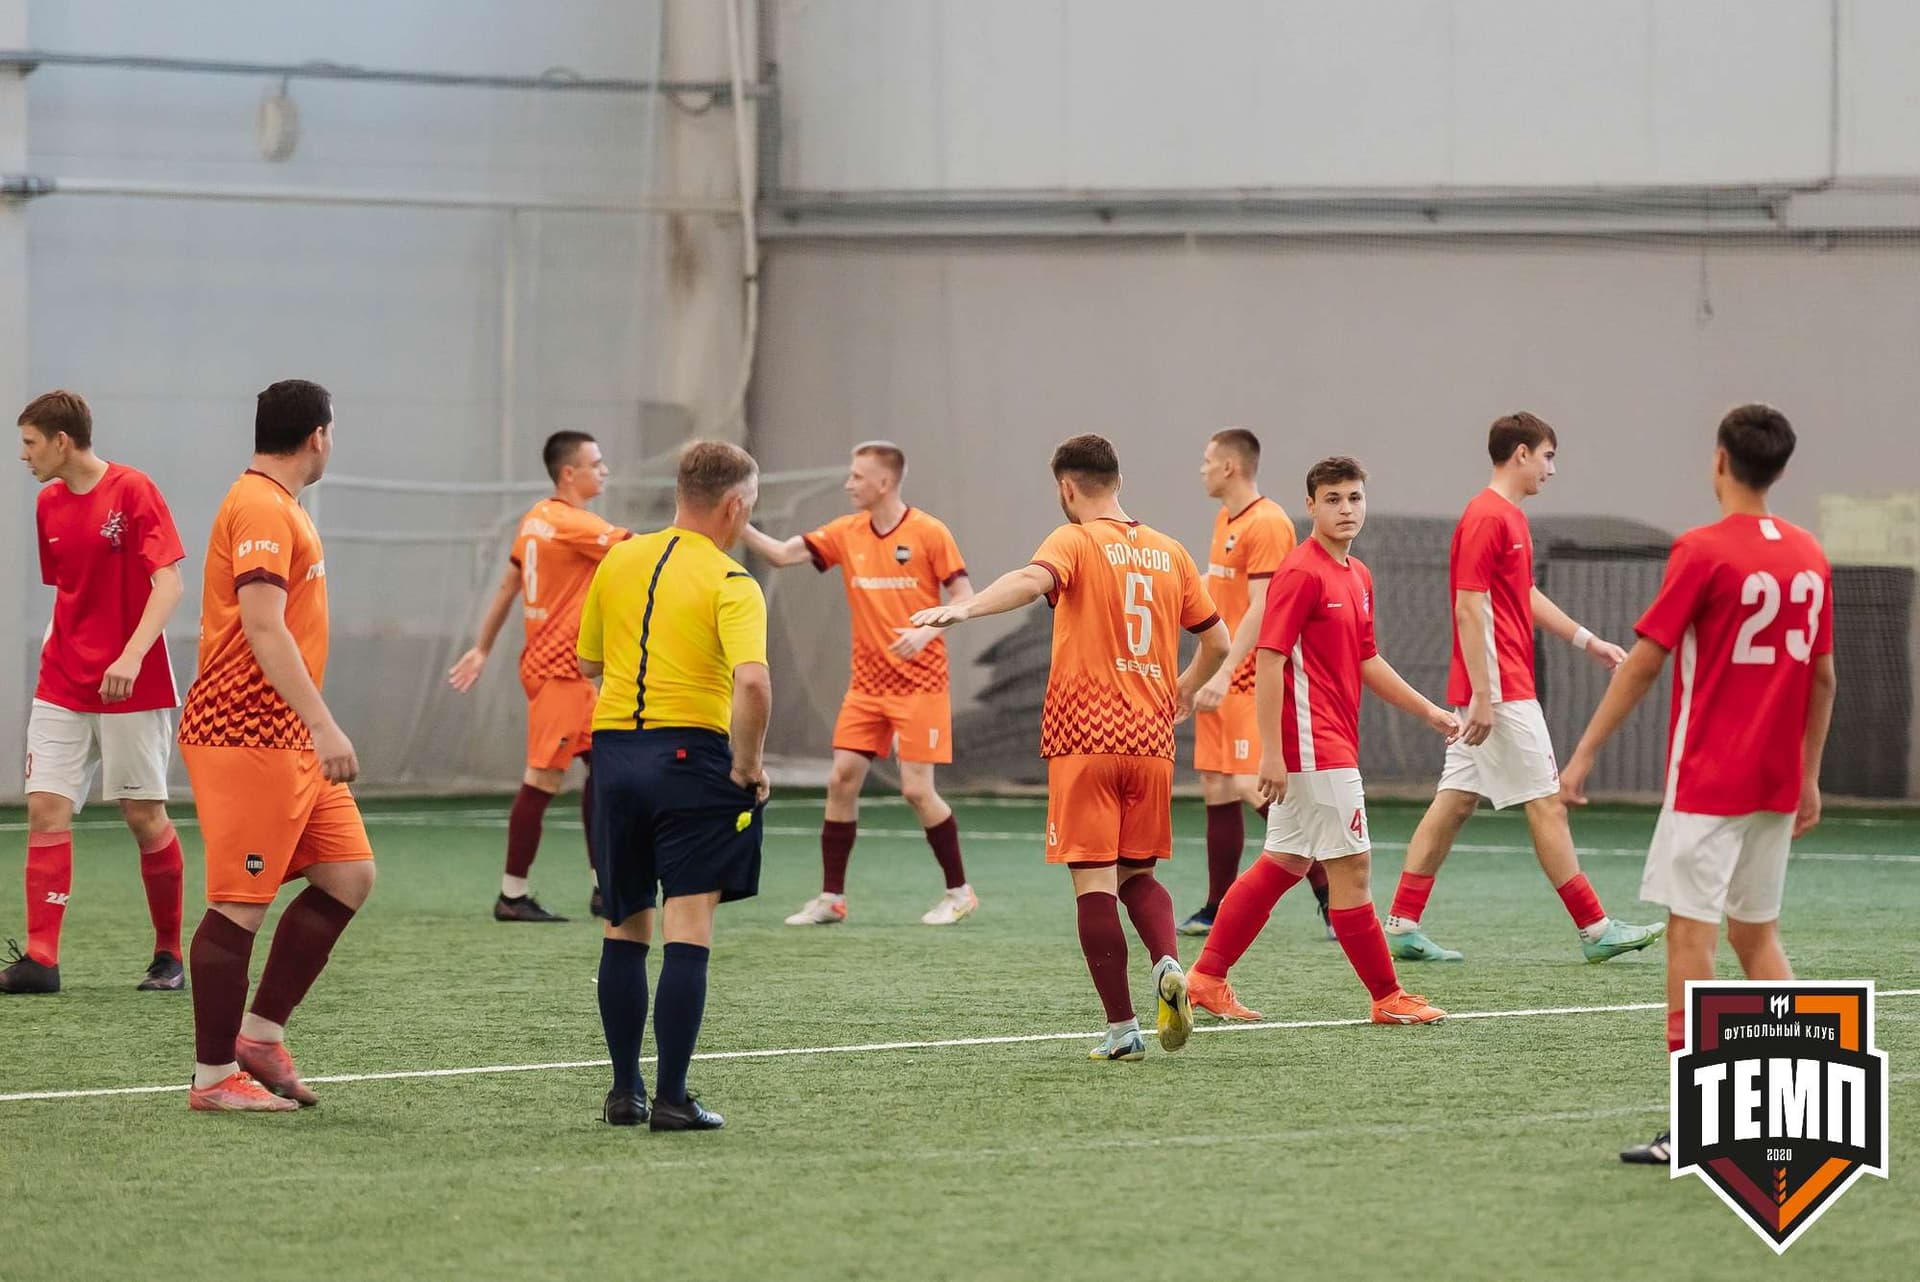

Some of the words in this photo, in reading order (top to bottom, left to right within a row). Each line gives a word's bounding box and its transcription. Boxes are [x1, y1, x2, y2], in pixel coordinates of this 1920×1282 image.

[1124, 572, 1153, 657] 5
[1731, 570, 1825, 665] 23
[1234, 739, 1249, 760] 19
[1350, 808, 1362, 839] 4
